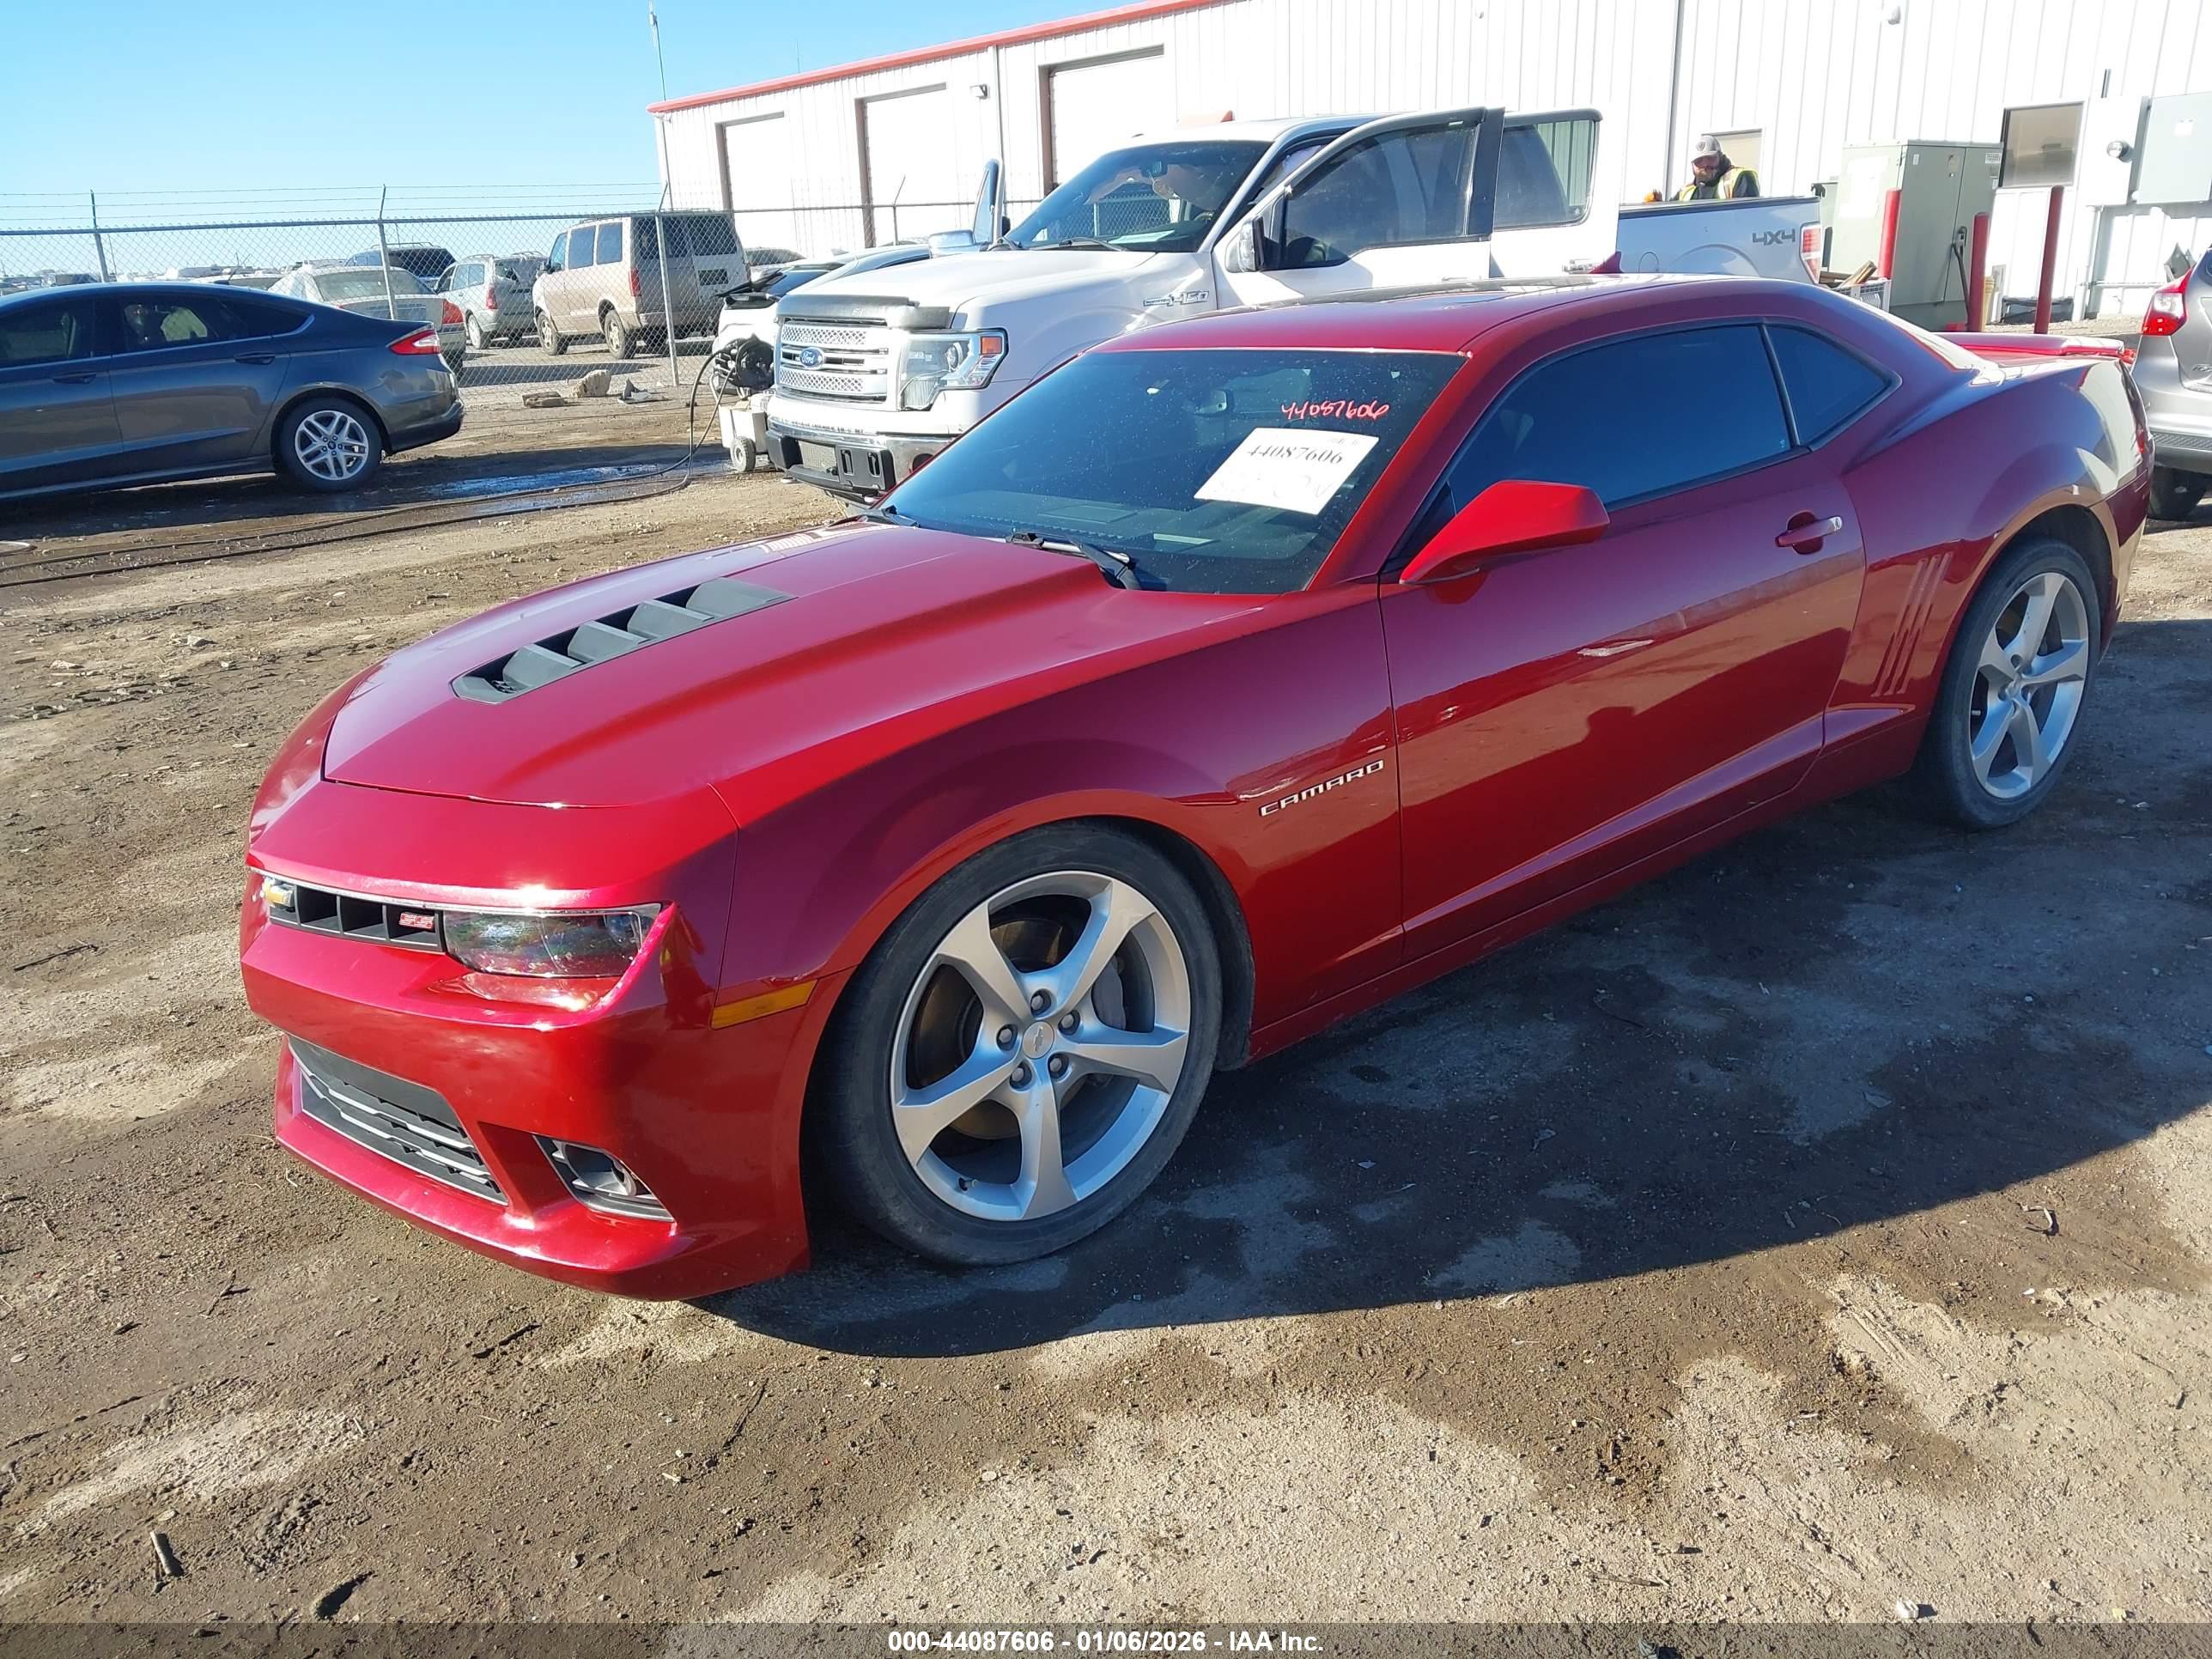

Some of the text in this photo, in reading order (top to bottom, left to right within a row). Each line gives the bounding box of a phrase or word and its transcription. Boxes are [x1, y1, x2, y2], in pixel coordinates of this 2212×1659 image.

[1753, 228, 1796, 246] 4X4
[1281, 400, 1390, 420] 44087606
[1248, 445, 1344, 465] 44087606
[1259, 759, 1384, 817] CAMARO
[398, 911, 434, 928] SS
